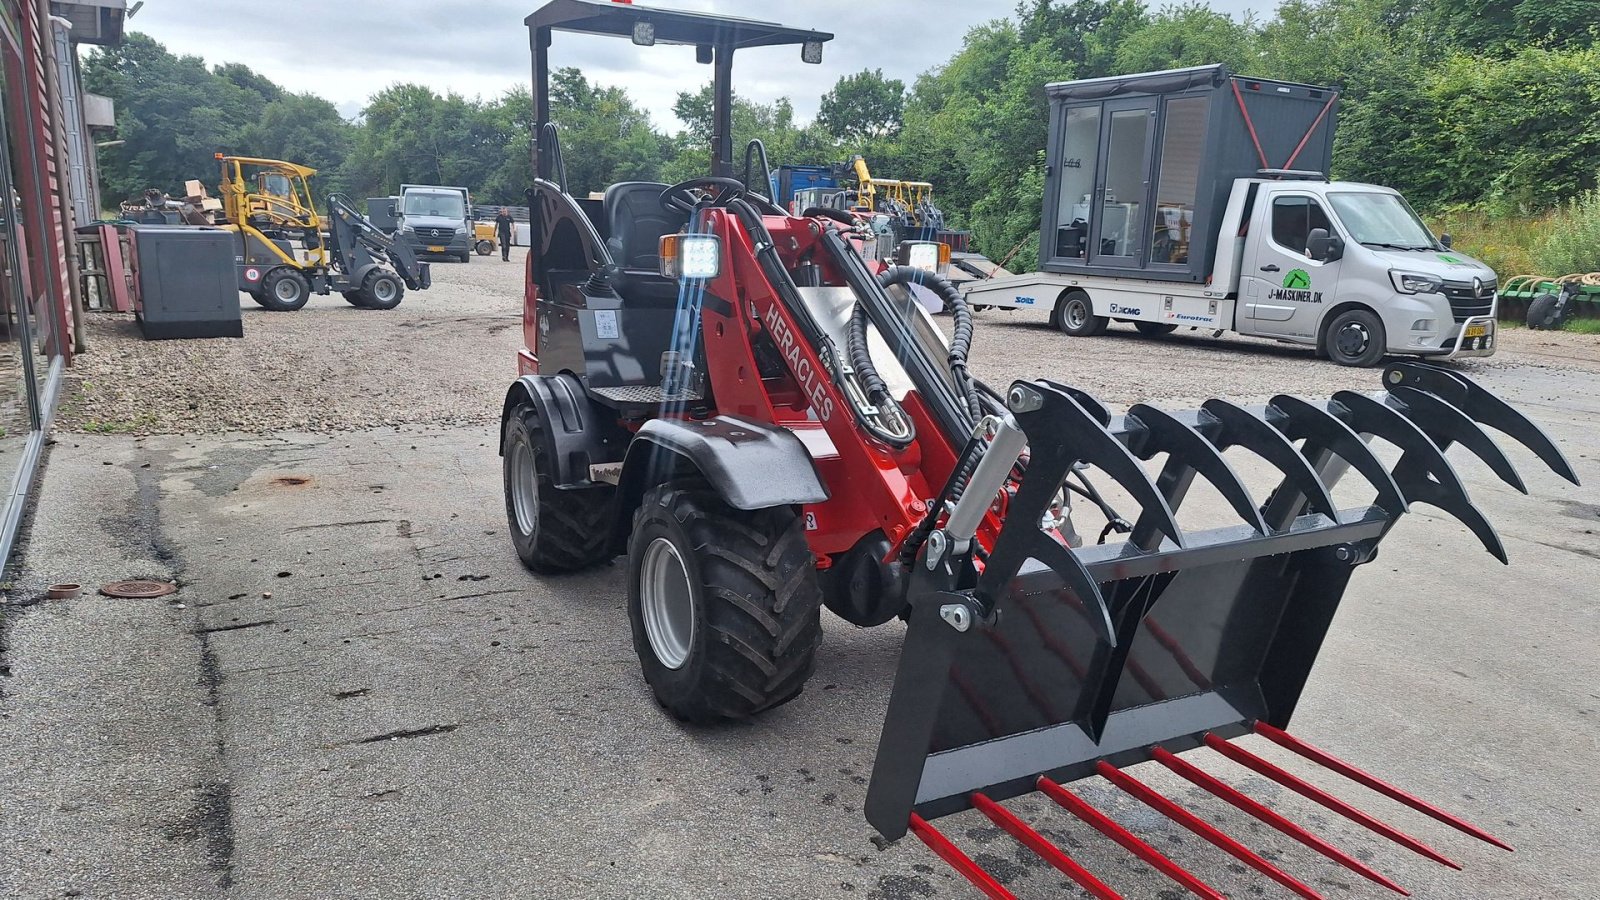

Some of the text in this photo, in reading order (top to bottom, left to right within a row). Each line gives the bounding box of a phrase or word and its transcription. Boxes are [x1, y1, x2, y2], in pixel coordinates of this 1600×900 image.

[1268, 289, 1323, 303] J-MASKINER.DK
[1176, 313, 1214, 322] Eurotrac
[765, 302, 834, 422] HERACLES
